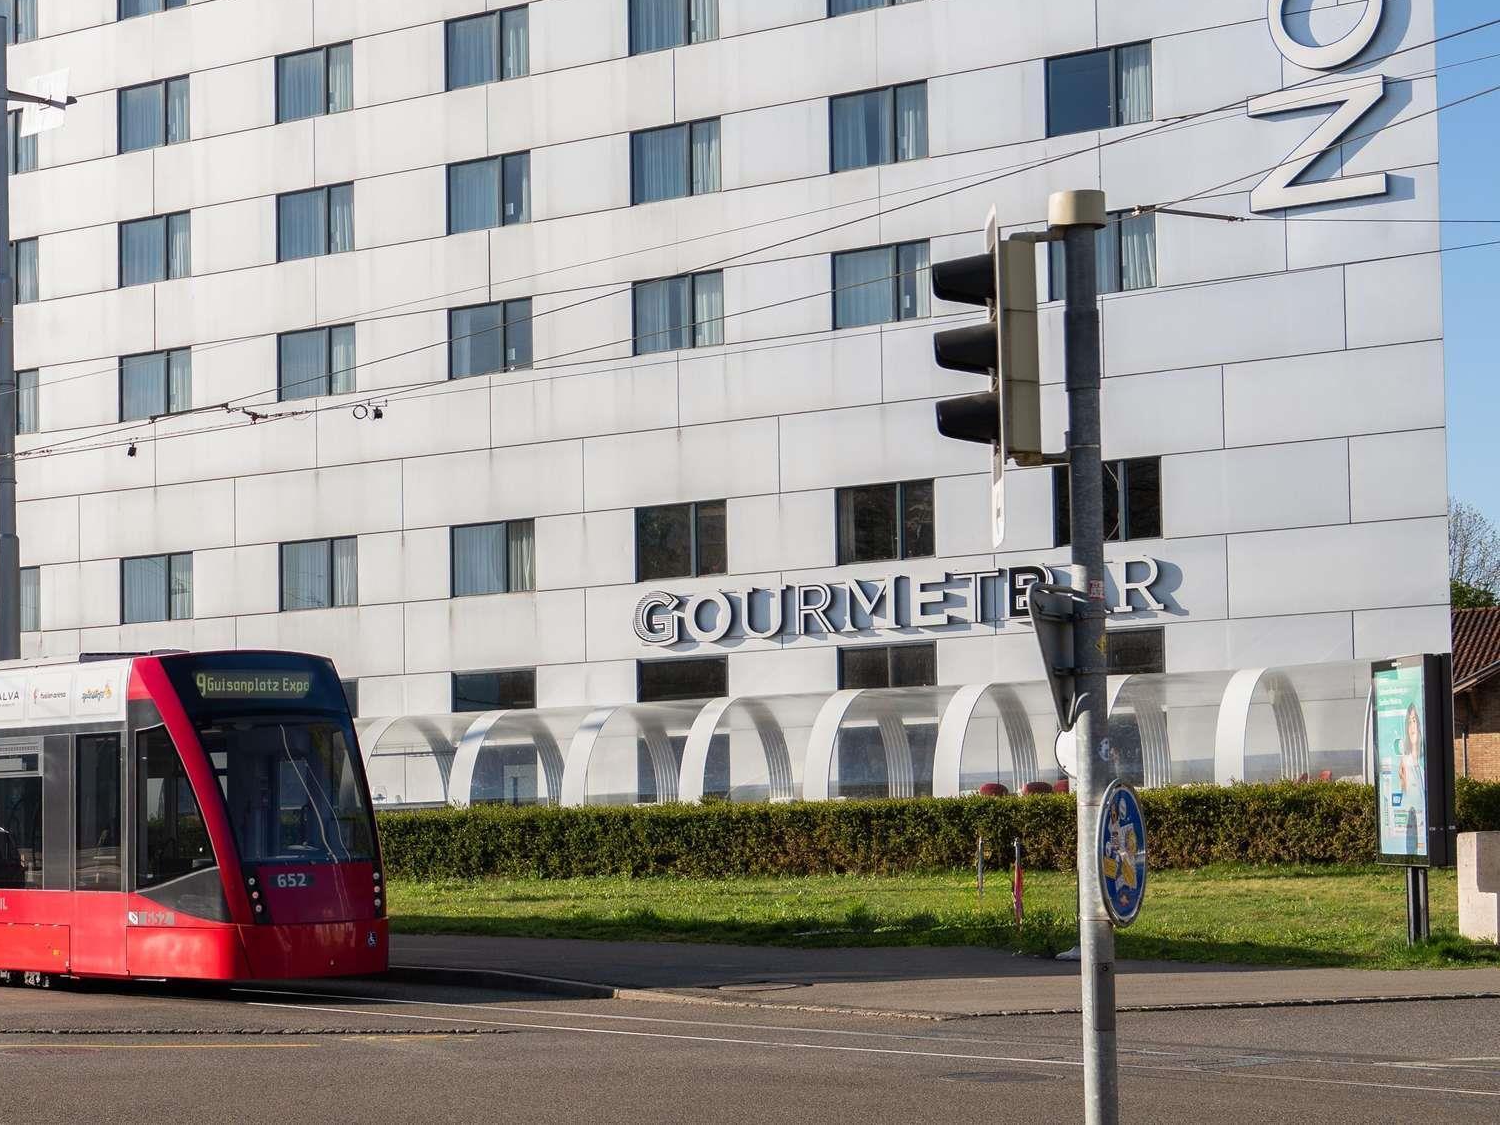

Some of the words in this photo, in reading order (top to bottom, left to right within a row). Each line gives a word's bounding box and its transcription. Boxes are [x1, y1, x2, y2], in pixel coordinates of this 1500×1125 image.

[633, 556, 1165, 646] GOURMETBR
[207, 677, 280, 693] Guisanplatz
[282, 677, 310, 693] Expo
[277, 873, 307, 888] 652
